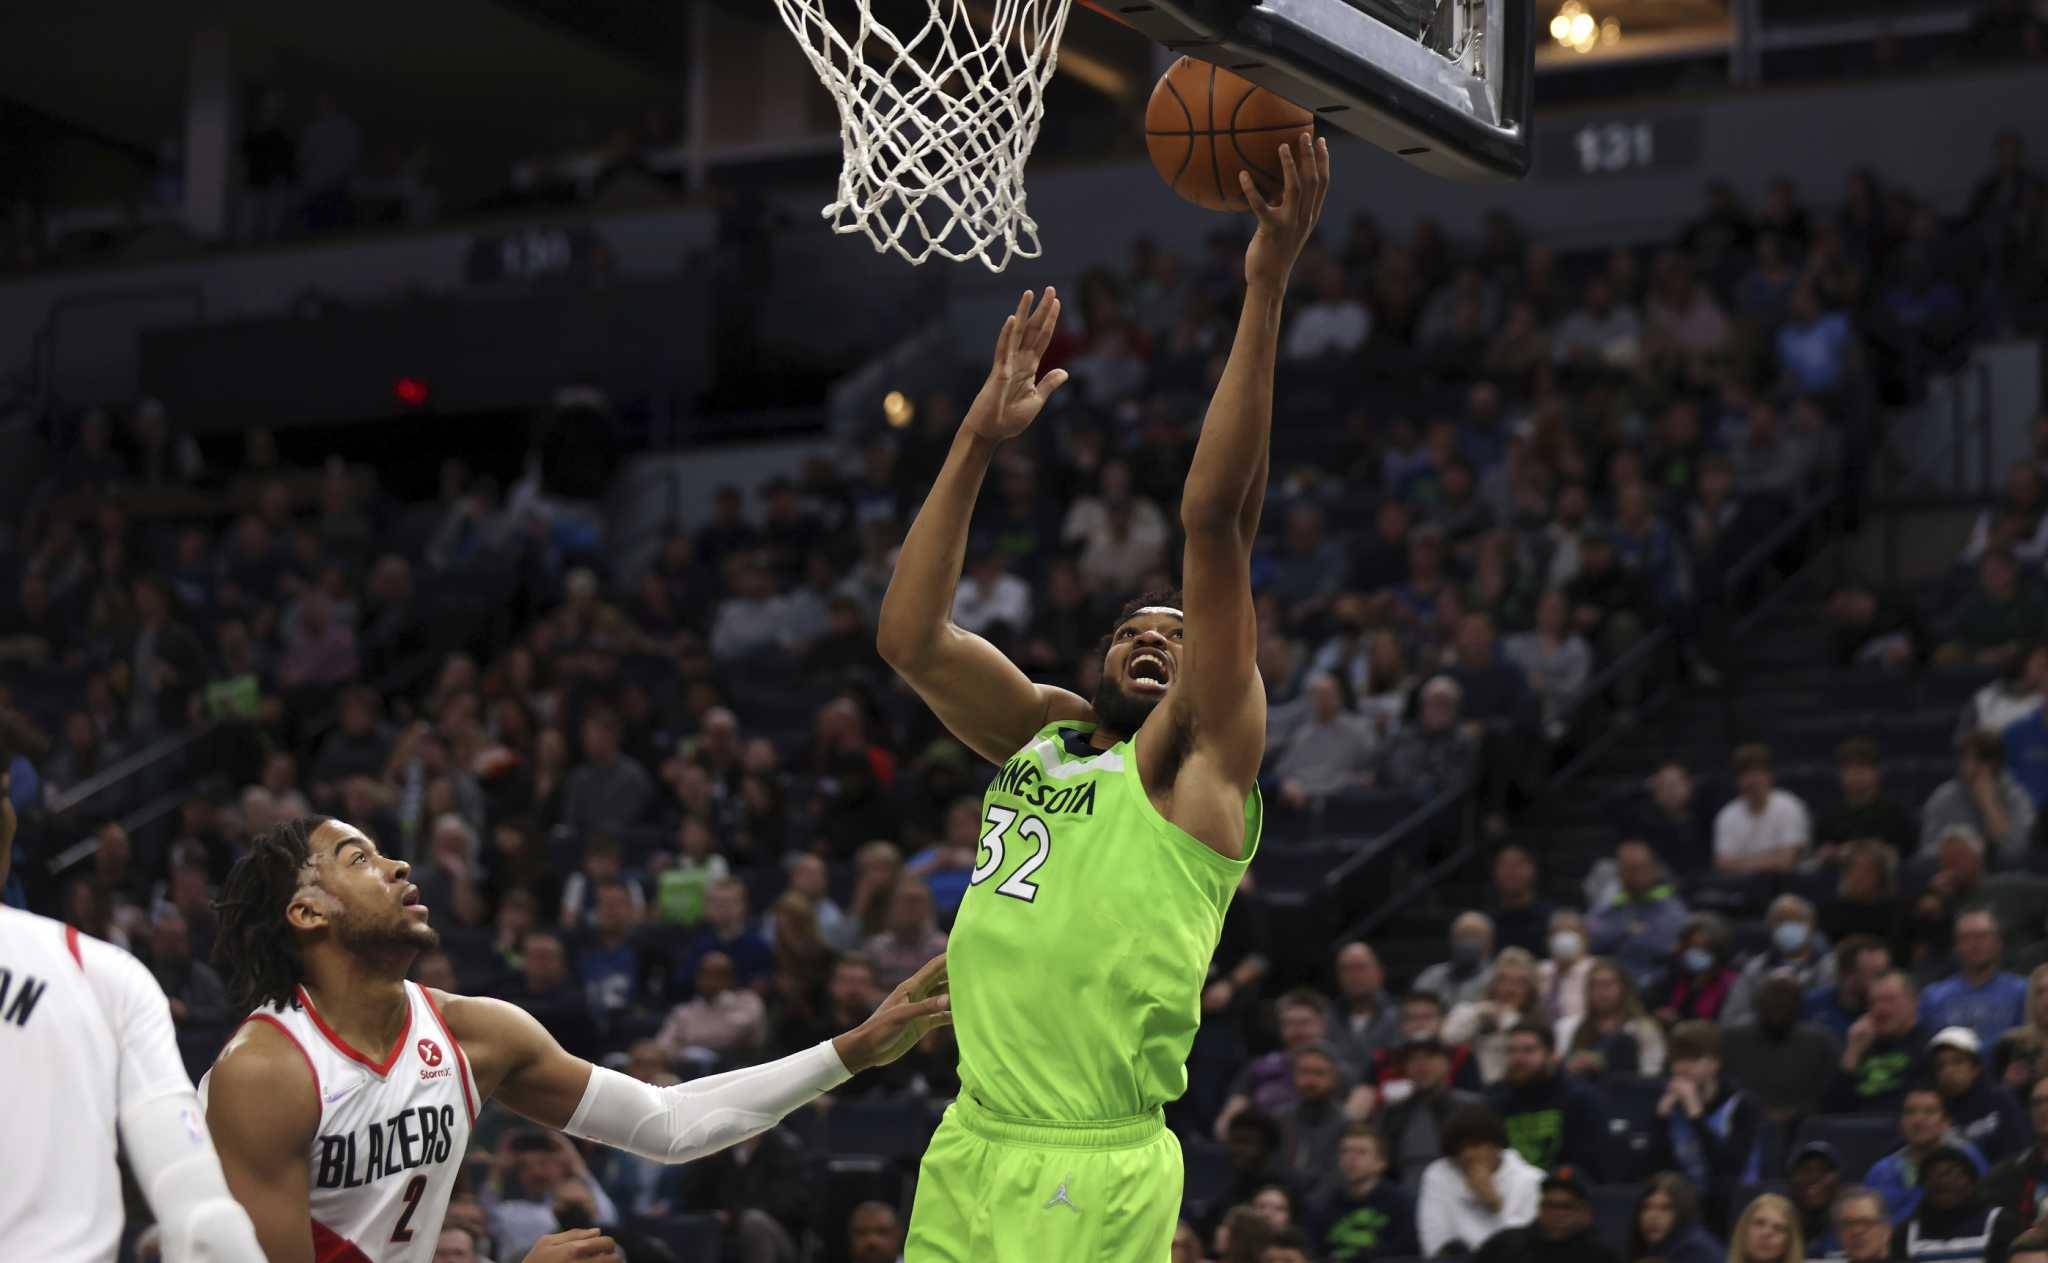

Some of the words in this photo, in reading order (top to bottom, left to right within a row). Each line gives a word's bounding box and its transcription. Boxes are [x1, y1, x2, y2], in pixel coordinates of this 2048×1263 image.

[988, 757, 1097, 816] NNESOTA
[971, 804, 1052, 904] 32
[317, 1104, 454, 1189] BLAZERS
[389, 1174, 428, 1243] 2
